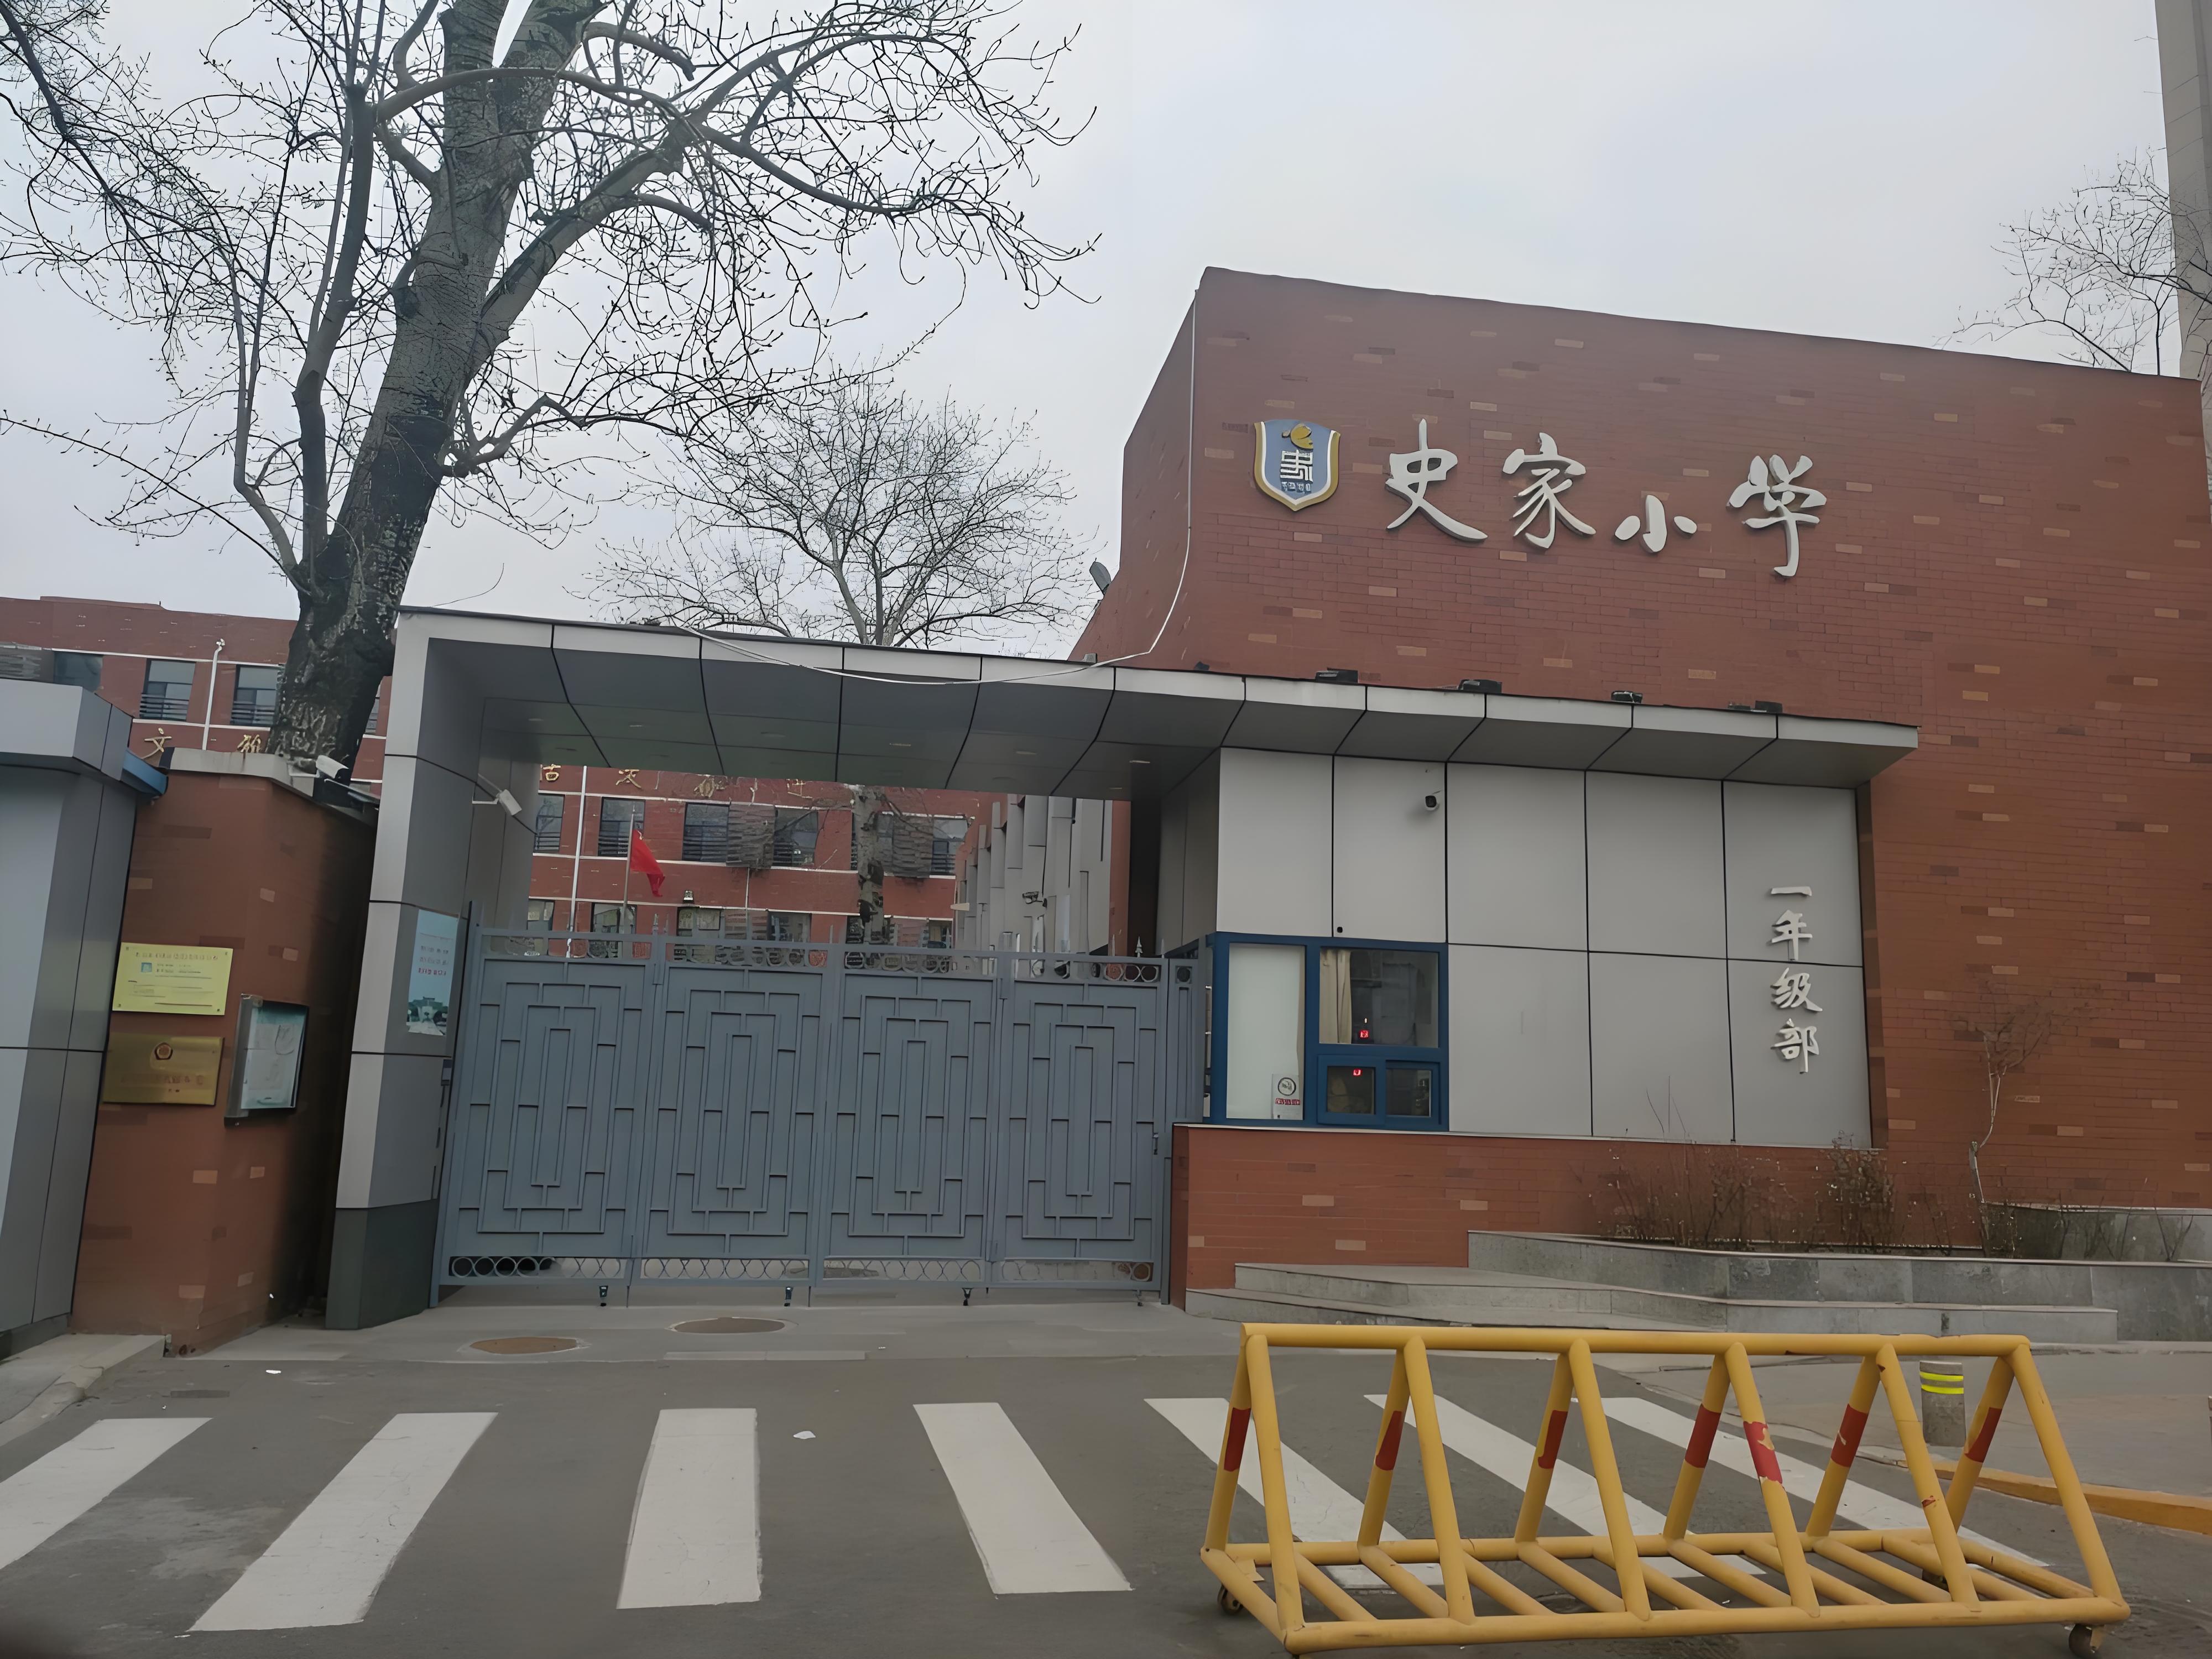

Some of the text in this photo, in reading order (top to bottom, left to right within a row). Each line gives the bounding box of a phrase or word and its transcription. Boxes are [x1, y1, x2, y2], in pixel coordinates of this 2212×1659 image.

[1385, 418, 1827, 578] 史家小学
[1770, 885, 1823, 1074] 一年级部
